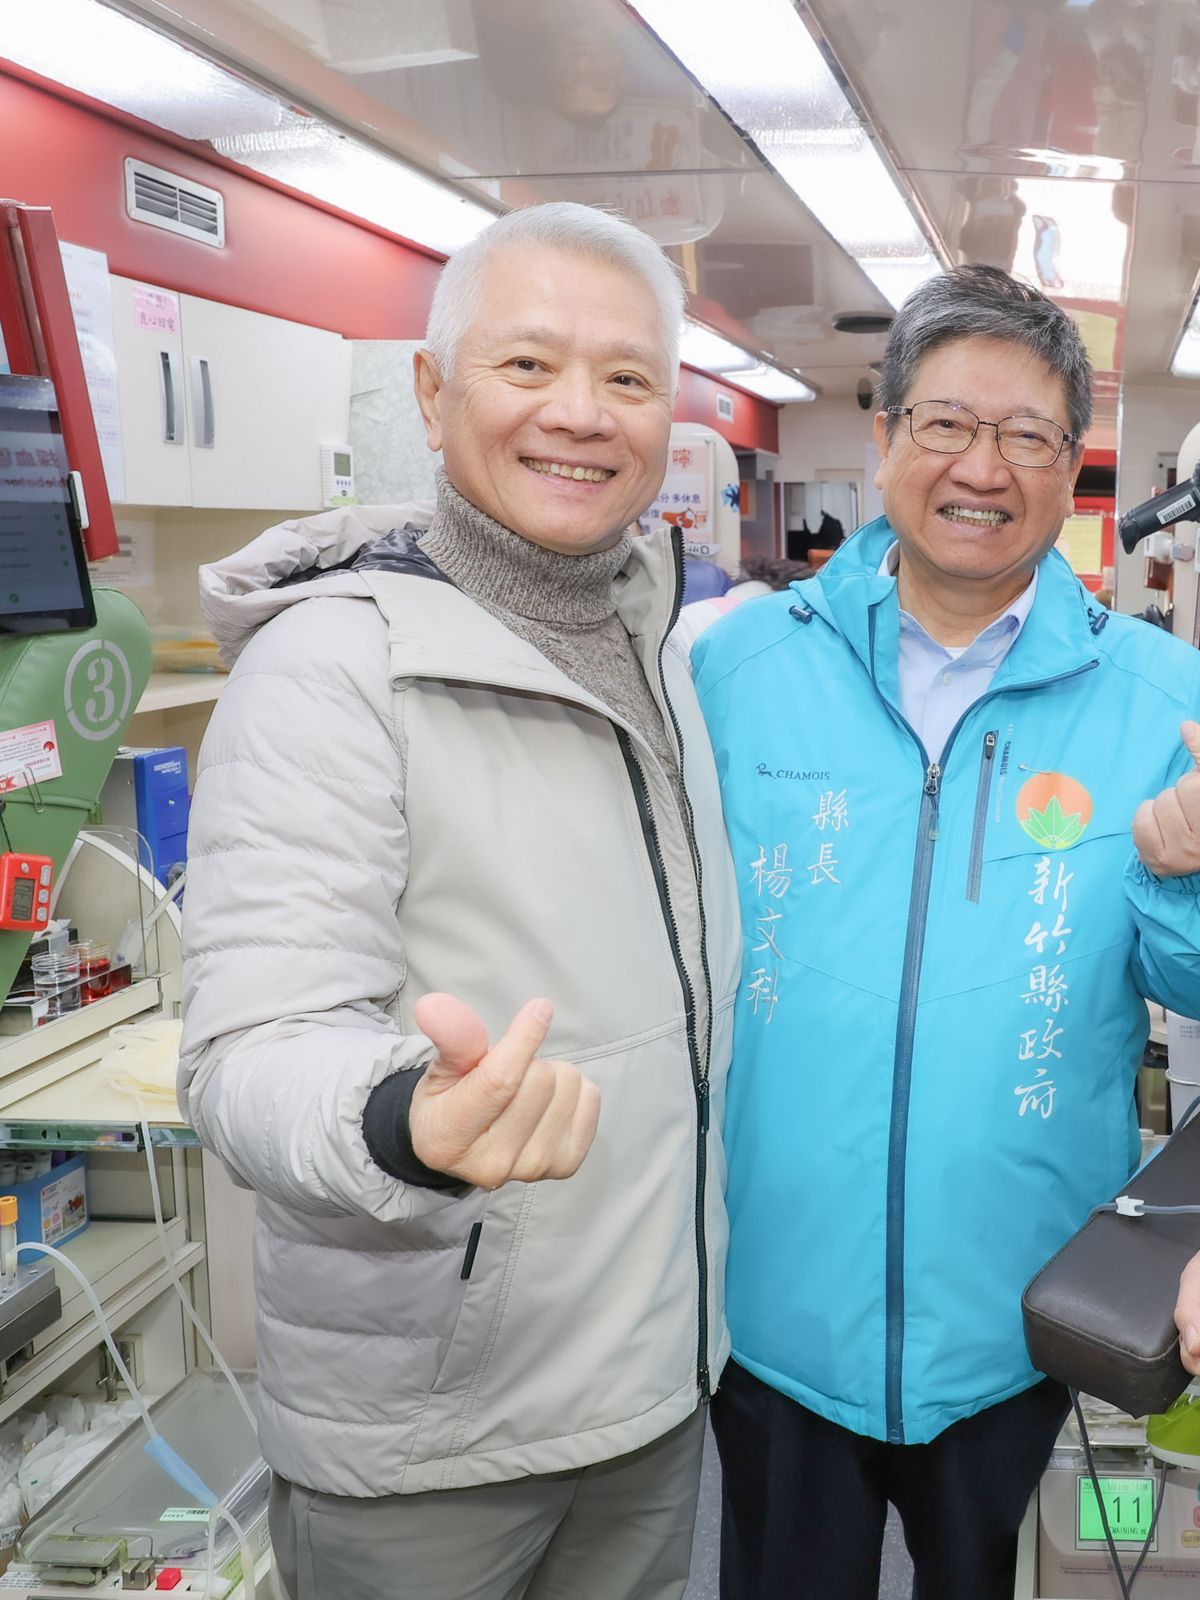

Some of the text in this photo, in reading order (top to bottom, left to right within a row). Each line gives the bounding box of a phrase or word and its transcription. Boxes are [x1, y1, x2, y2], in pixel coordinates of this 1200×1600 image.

[86, 658, 115, 723] 3
[776, 769, 830, 781] CHAMOIS
[807, 788, 849, 885] 縣長
[746, 842, 793, 1024] 楊文科
[1014, 855, 1074, 1119] 新竹縣政府
[1113, 1496, 1140, 1523] 11
